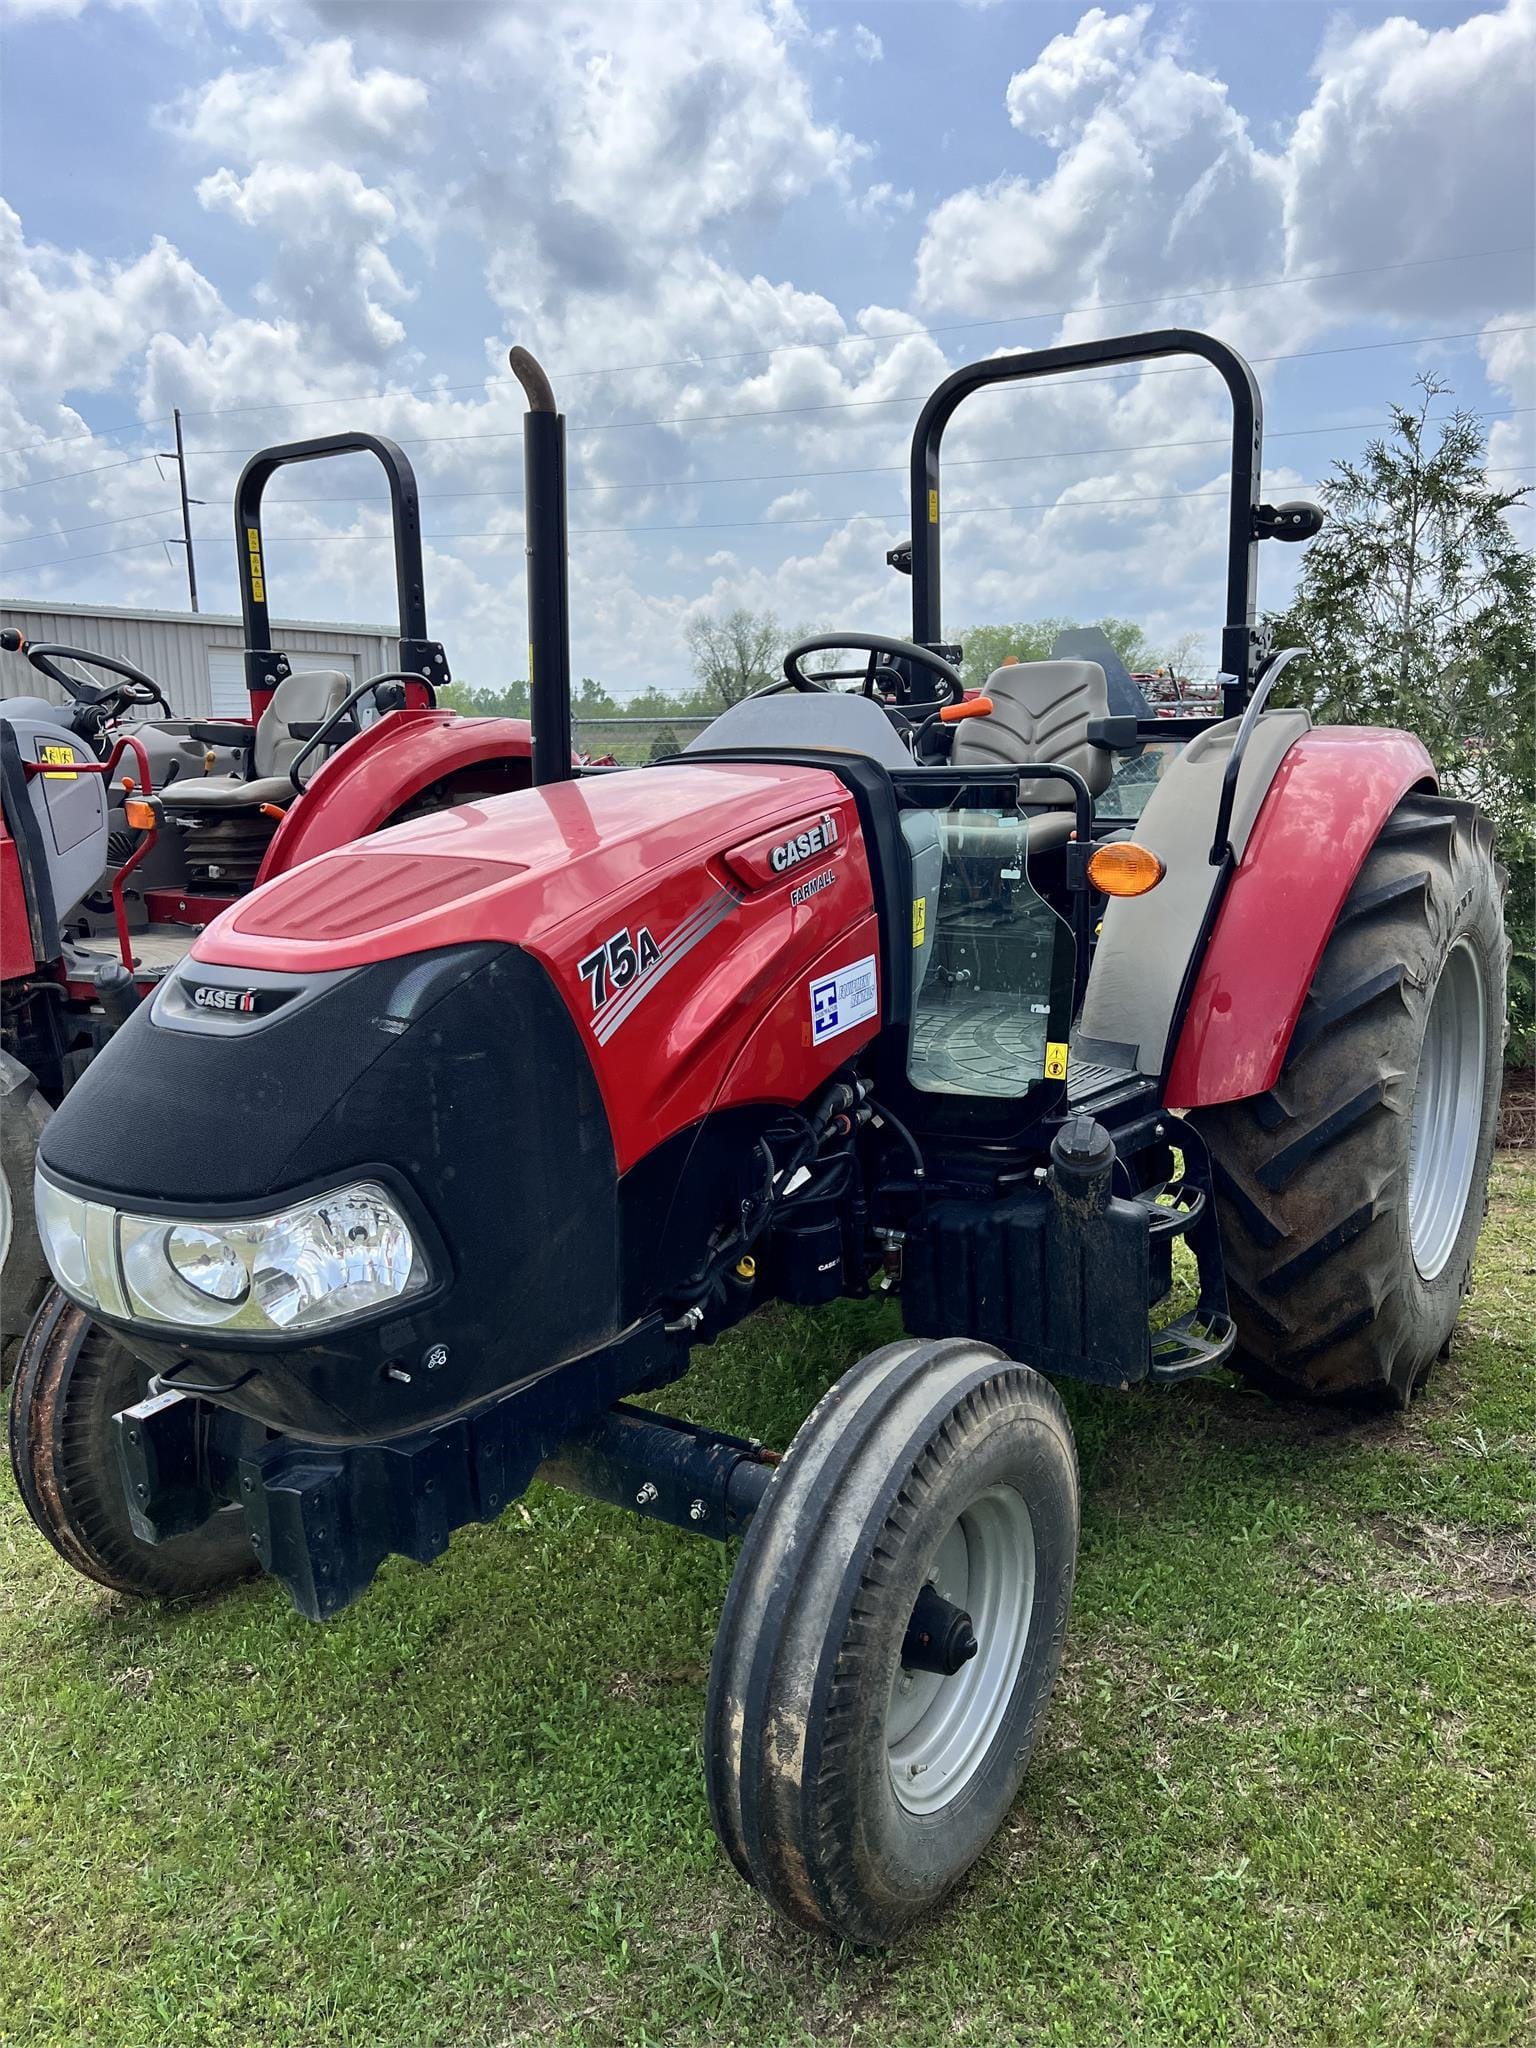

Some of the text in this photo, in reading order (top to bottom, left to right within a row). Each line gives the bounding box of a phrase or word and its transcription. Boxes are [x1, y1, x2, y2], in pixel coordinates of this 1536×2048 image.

[771, 827, 822, 872] CASE
[790, 869, 836, 907] FARMALL
[576, 926, 664, 1011] 75A
[194, 987, 236, 1010] CASE
